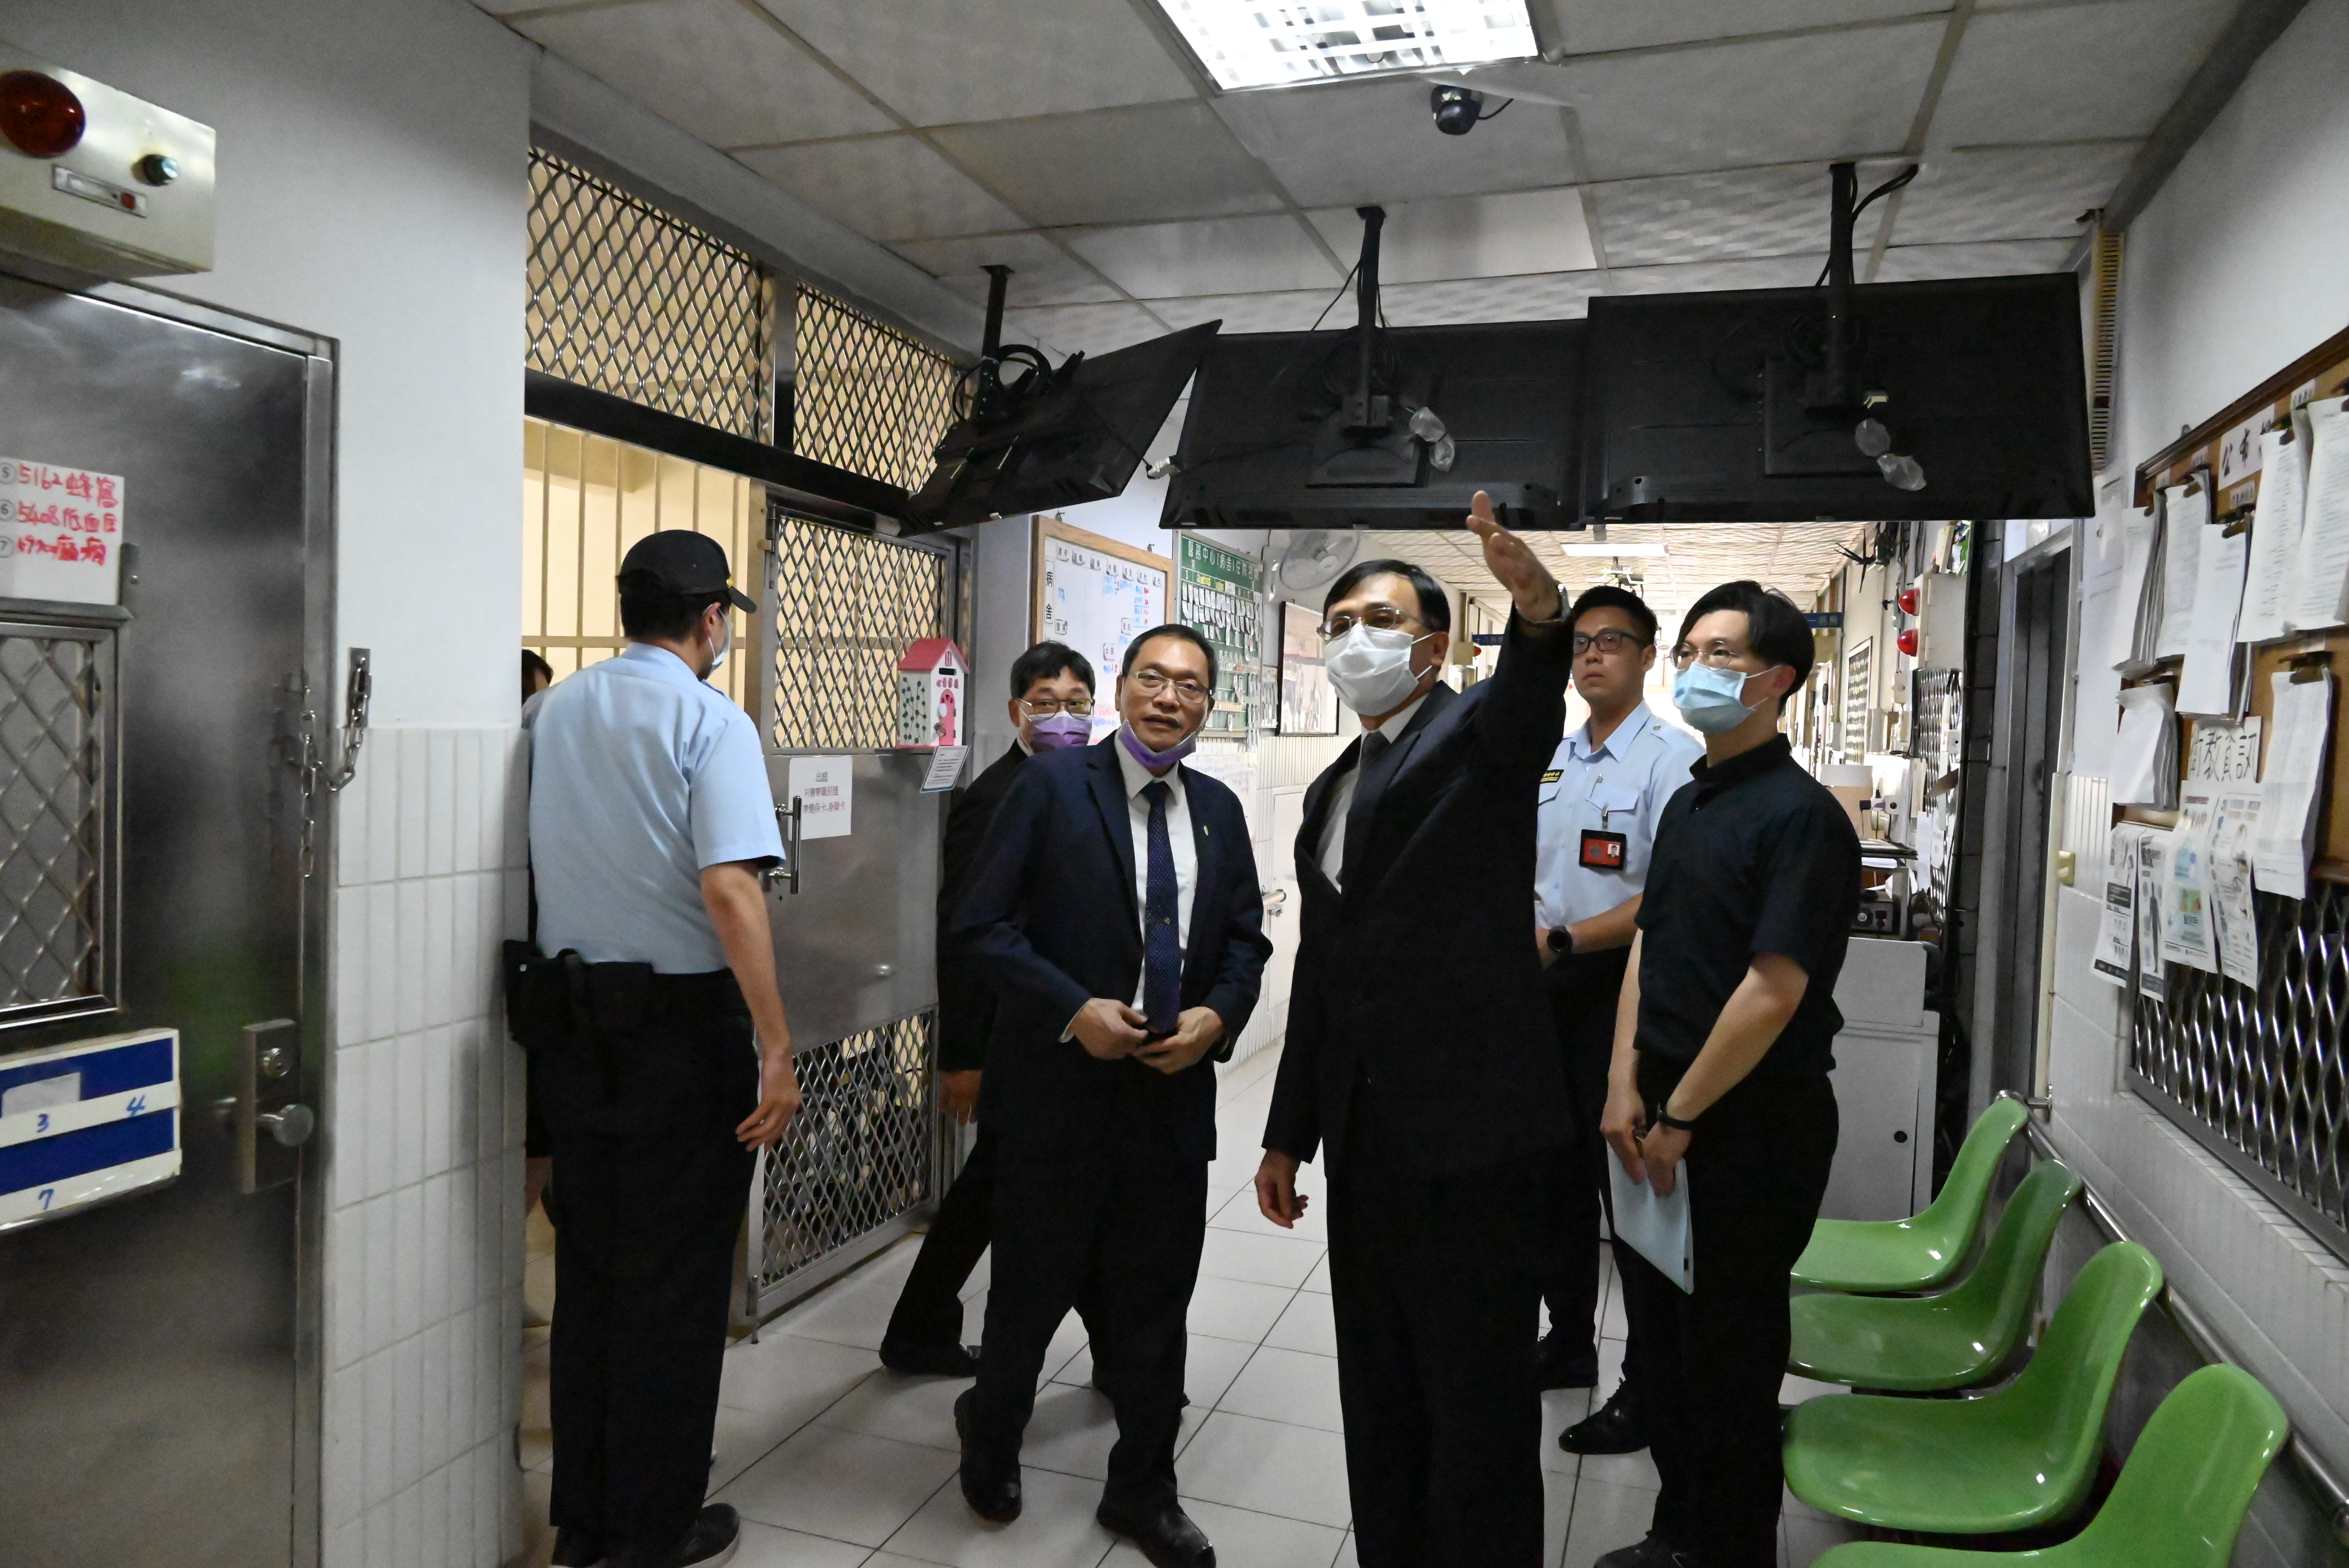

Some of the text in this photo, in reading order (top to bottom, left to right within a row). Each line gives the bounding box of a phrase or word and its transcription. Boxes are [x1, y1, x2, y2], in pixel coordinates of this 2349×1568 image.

[816, 771, 828, 782] 出庭
[36, 1095, 146, 1133] 3 4
[38, 1188, 54, 1210] 7
